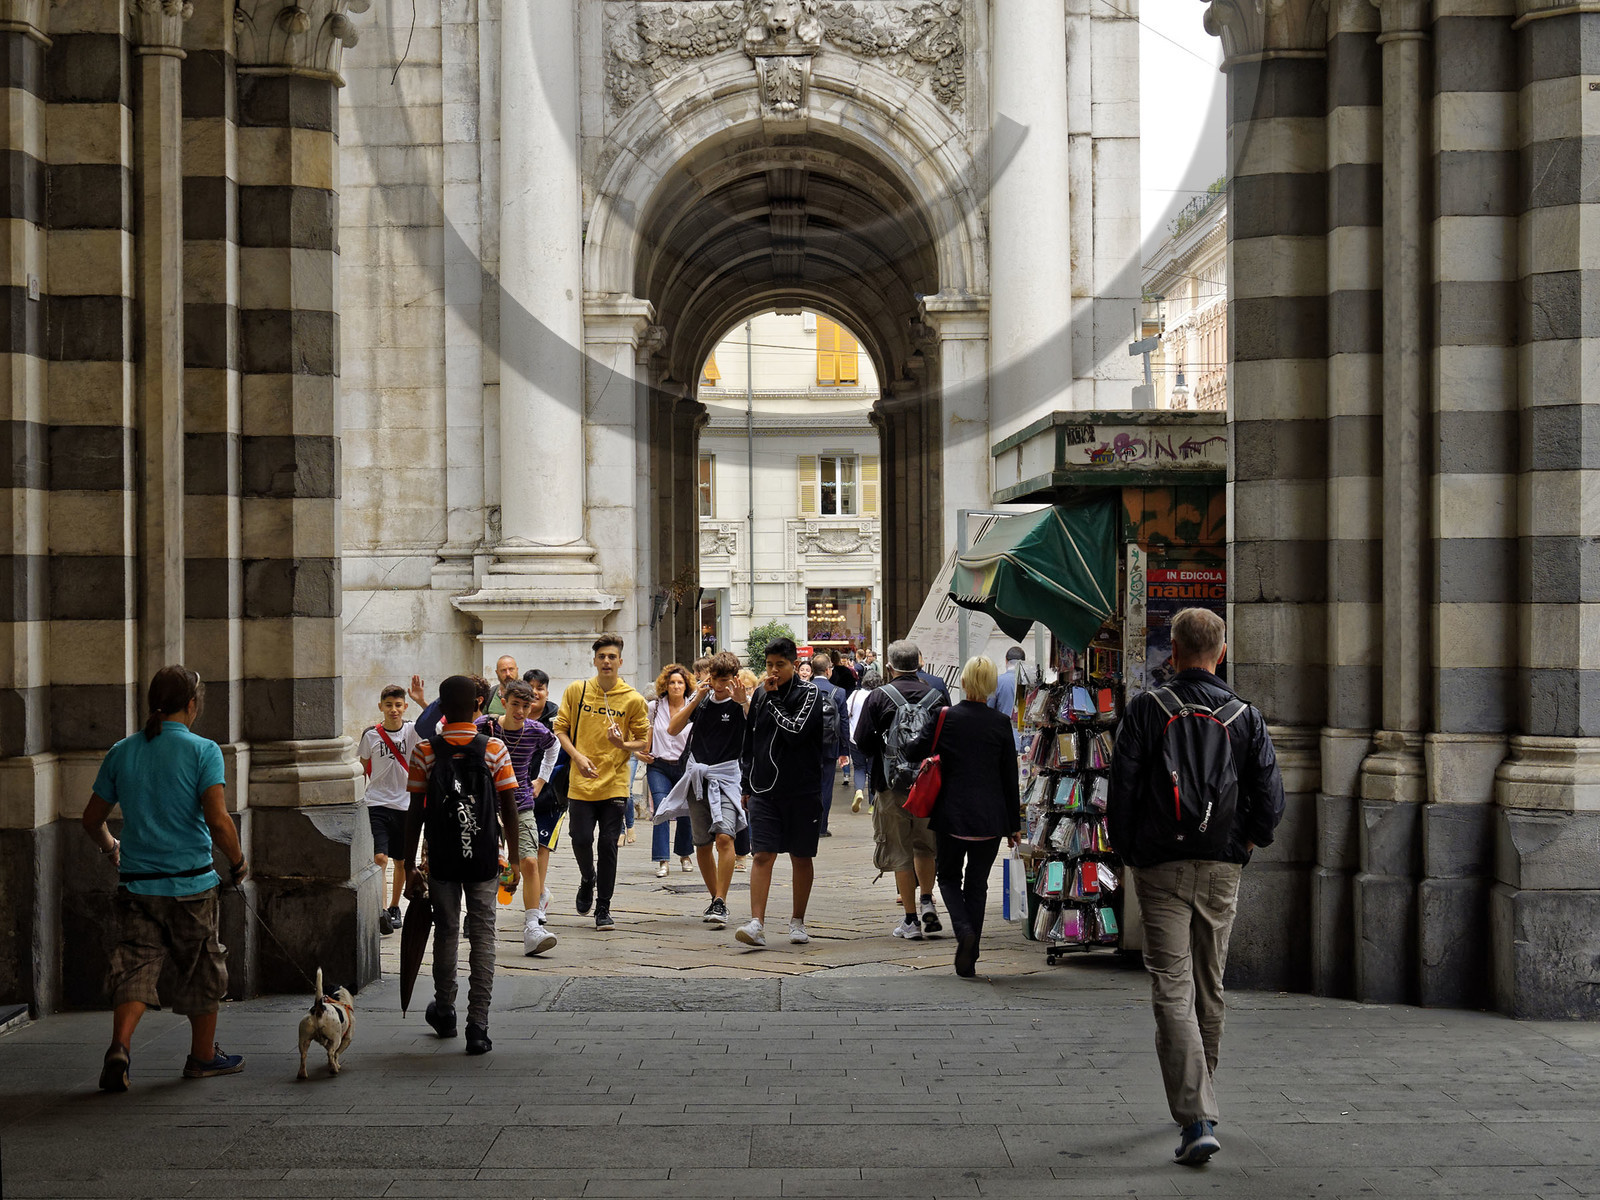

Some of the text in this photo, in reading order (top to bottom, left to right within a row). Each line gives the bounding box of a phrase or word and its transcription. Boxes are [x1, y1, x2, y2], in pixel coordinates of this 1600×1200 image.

[1166, 571, 1223, 580] IN EDICOLA
[1148, 583, 1225, 599] nautic
